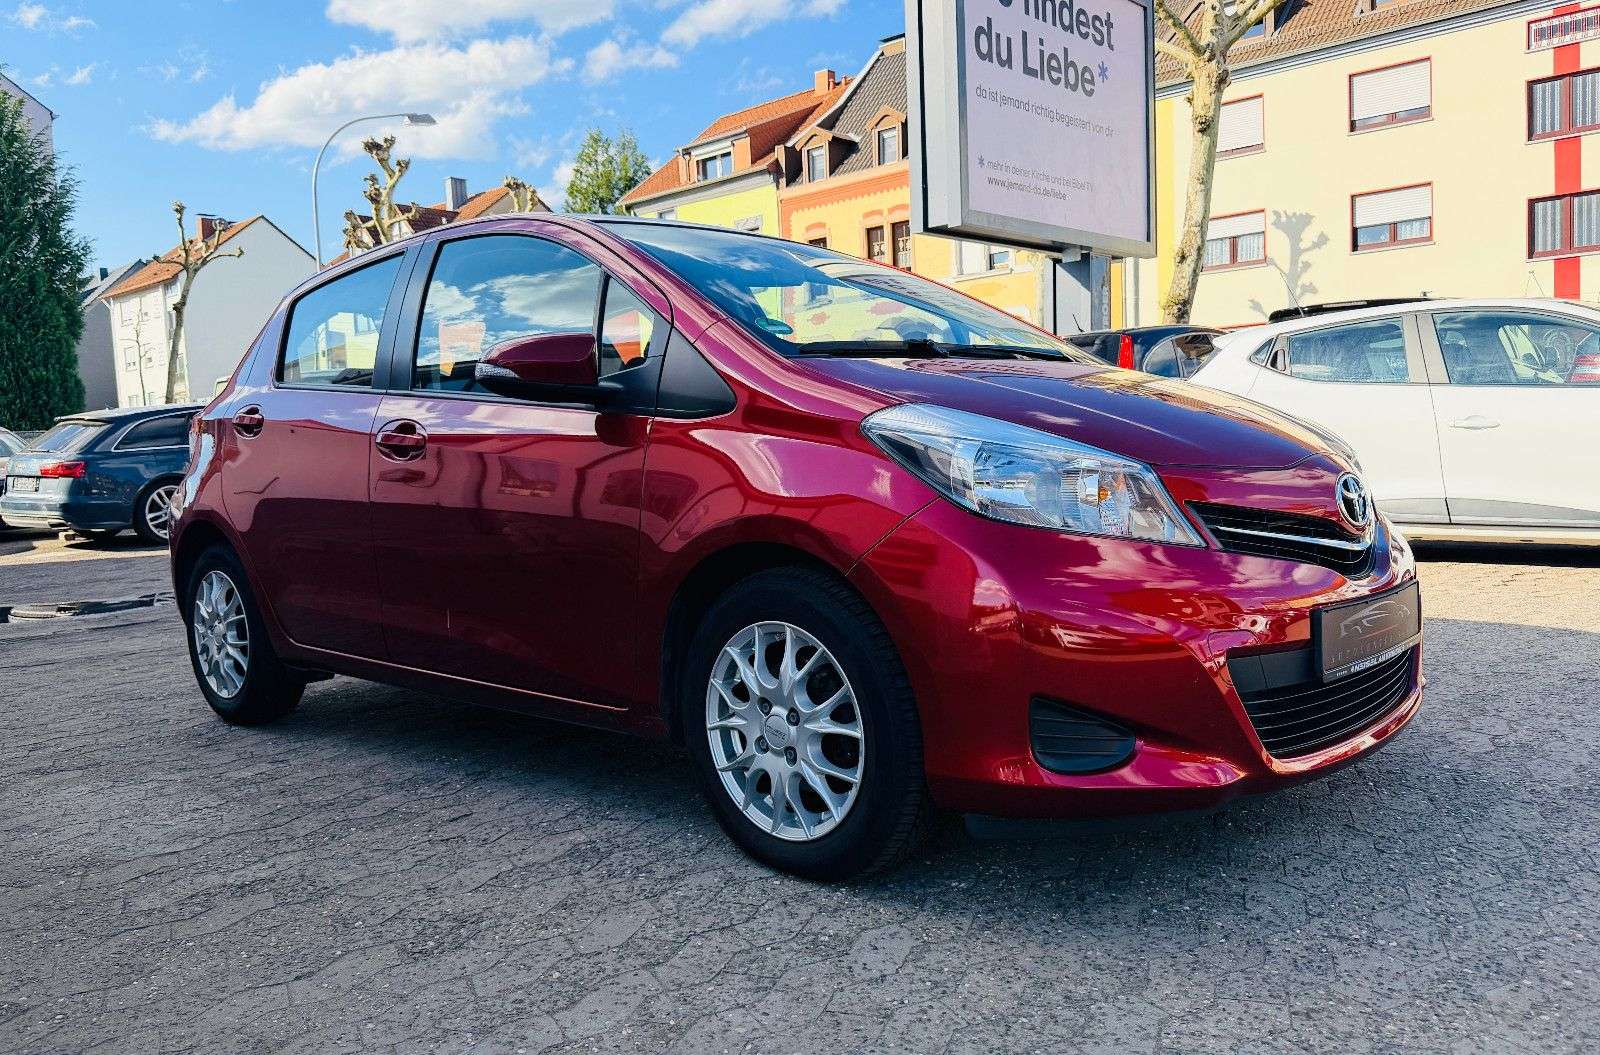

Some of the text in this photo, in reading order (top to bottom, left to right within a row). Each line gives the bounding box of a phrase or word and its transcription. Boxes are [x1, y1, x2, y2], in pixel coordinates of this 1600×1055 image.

[974, 16, 1012, 70] du
[975, 84, 987, 99] da
[988, 87, 999, 102] ist
[999, 91, 1030, 112] jemand
[1031, 103, 1055, 122] richtig
